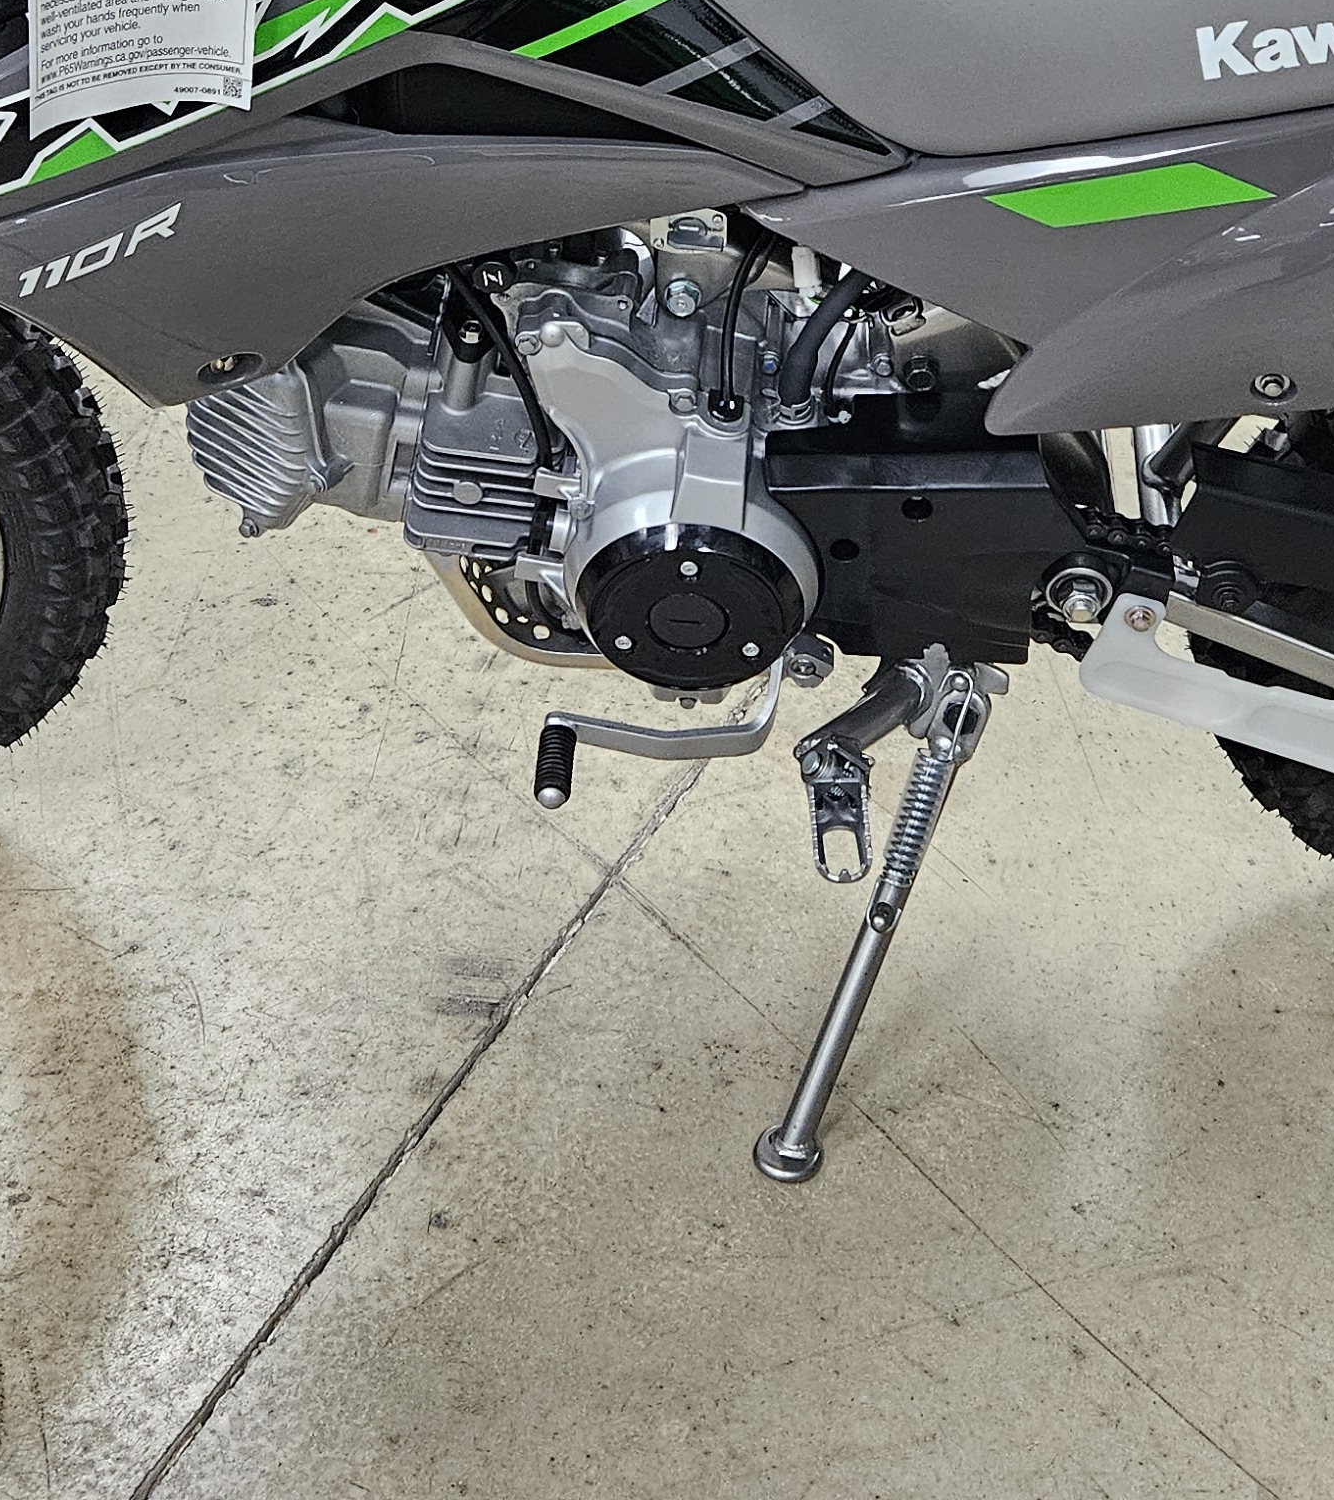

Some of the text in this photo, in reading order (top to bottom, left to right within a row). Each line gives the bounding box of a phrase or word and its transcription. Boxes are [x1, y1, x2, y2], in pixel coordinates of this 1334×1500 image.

[41, 2, 200, 39] wash your hands frequently when
[41, 20, 140, 53] servicing your vehicle.
[41, 35, 163, 71] For more information go to
[66, 80, 80, 89] NOT
[81, 77, 90, 85] TO
[92, 74, 101, 82] BE
[103, 66, 137, 80] REMOVED
[139, 63, 168, 72] EXCEPT
[174, 87, 221, 95] 49007-0891
